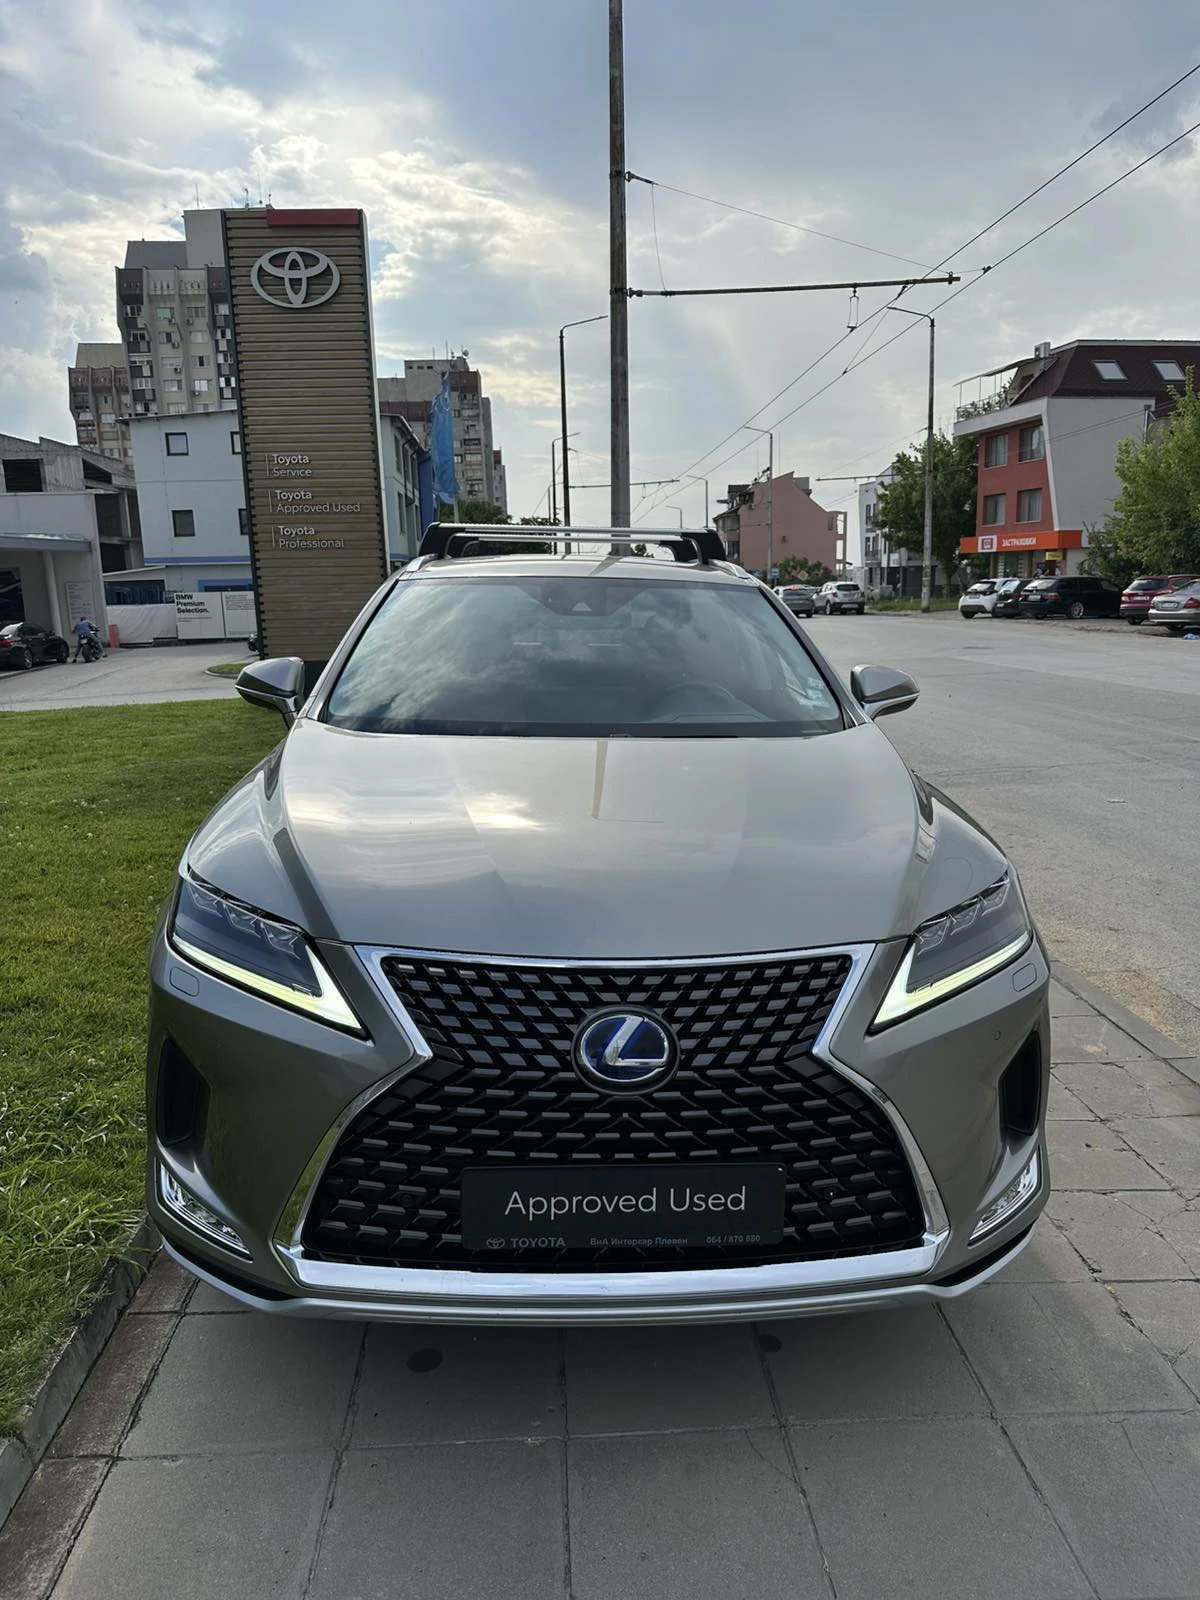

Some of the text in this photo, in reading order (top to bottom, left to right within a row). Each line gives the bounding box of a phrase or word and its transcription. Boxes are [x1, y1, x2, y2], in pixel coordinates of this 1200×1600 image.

[272, 453, 309, 466] Toyota
[273, 467, 312, 477] Service
[275, 489, 312, 502] Toyota
[276, 502, 360, 515] Approved Used
[278, 525, 315, 537] Toyota
[279, 538, 345, 549] Professional
[504, 1185, 747, 1221] Approved Used
[510, 1237, 567, 1248] TOYOTA
